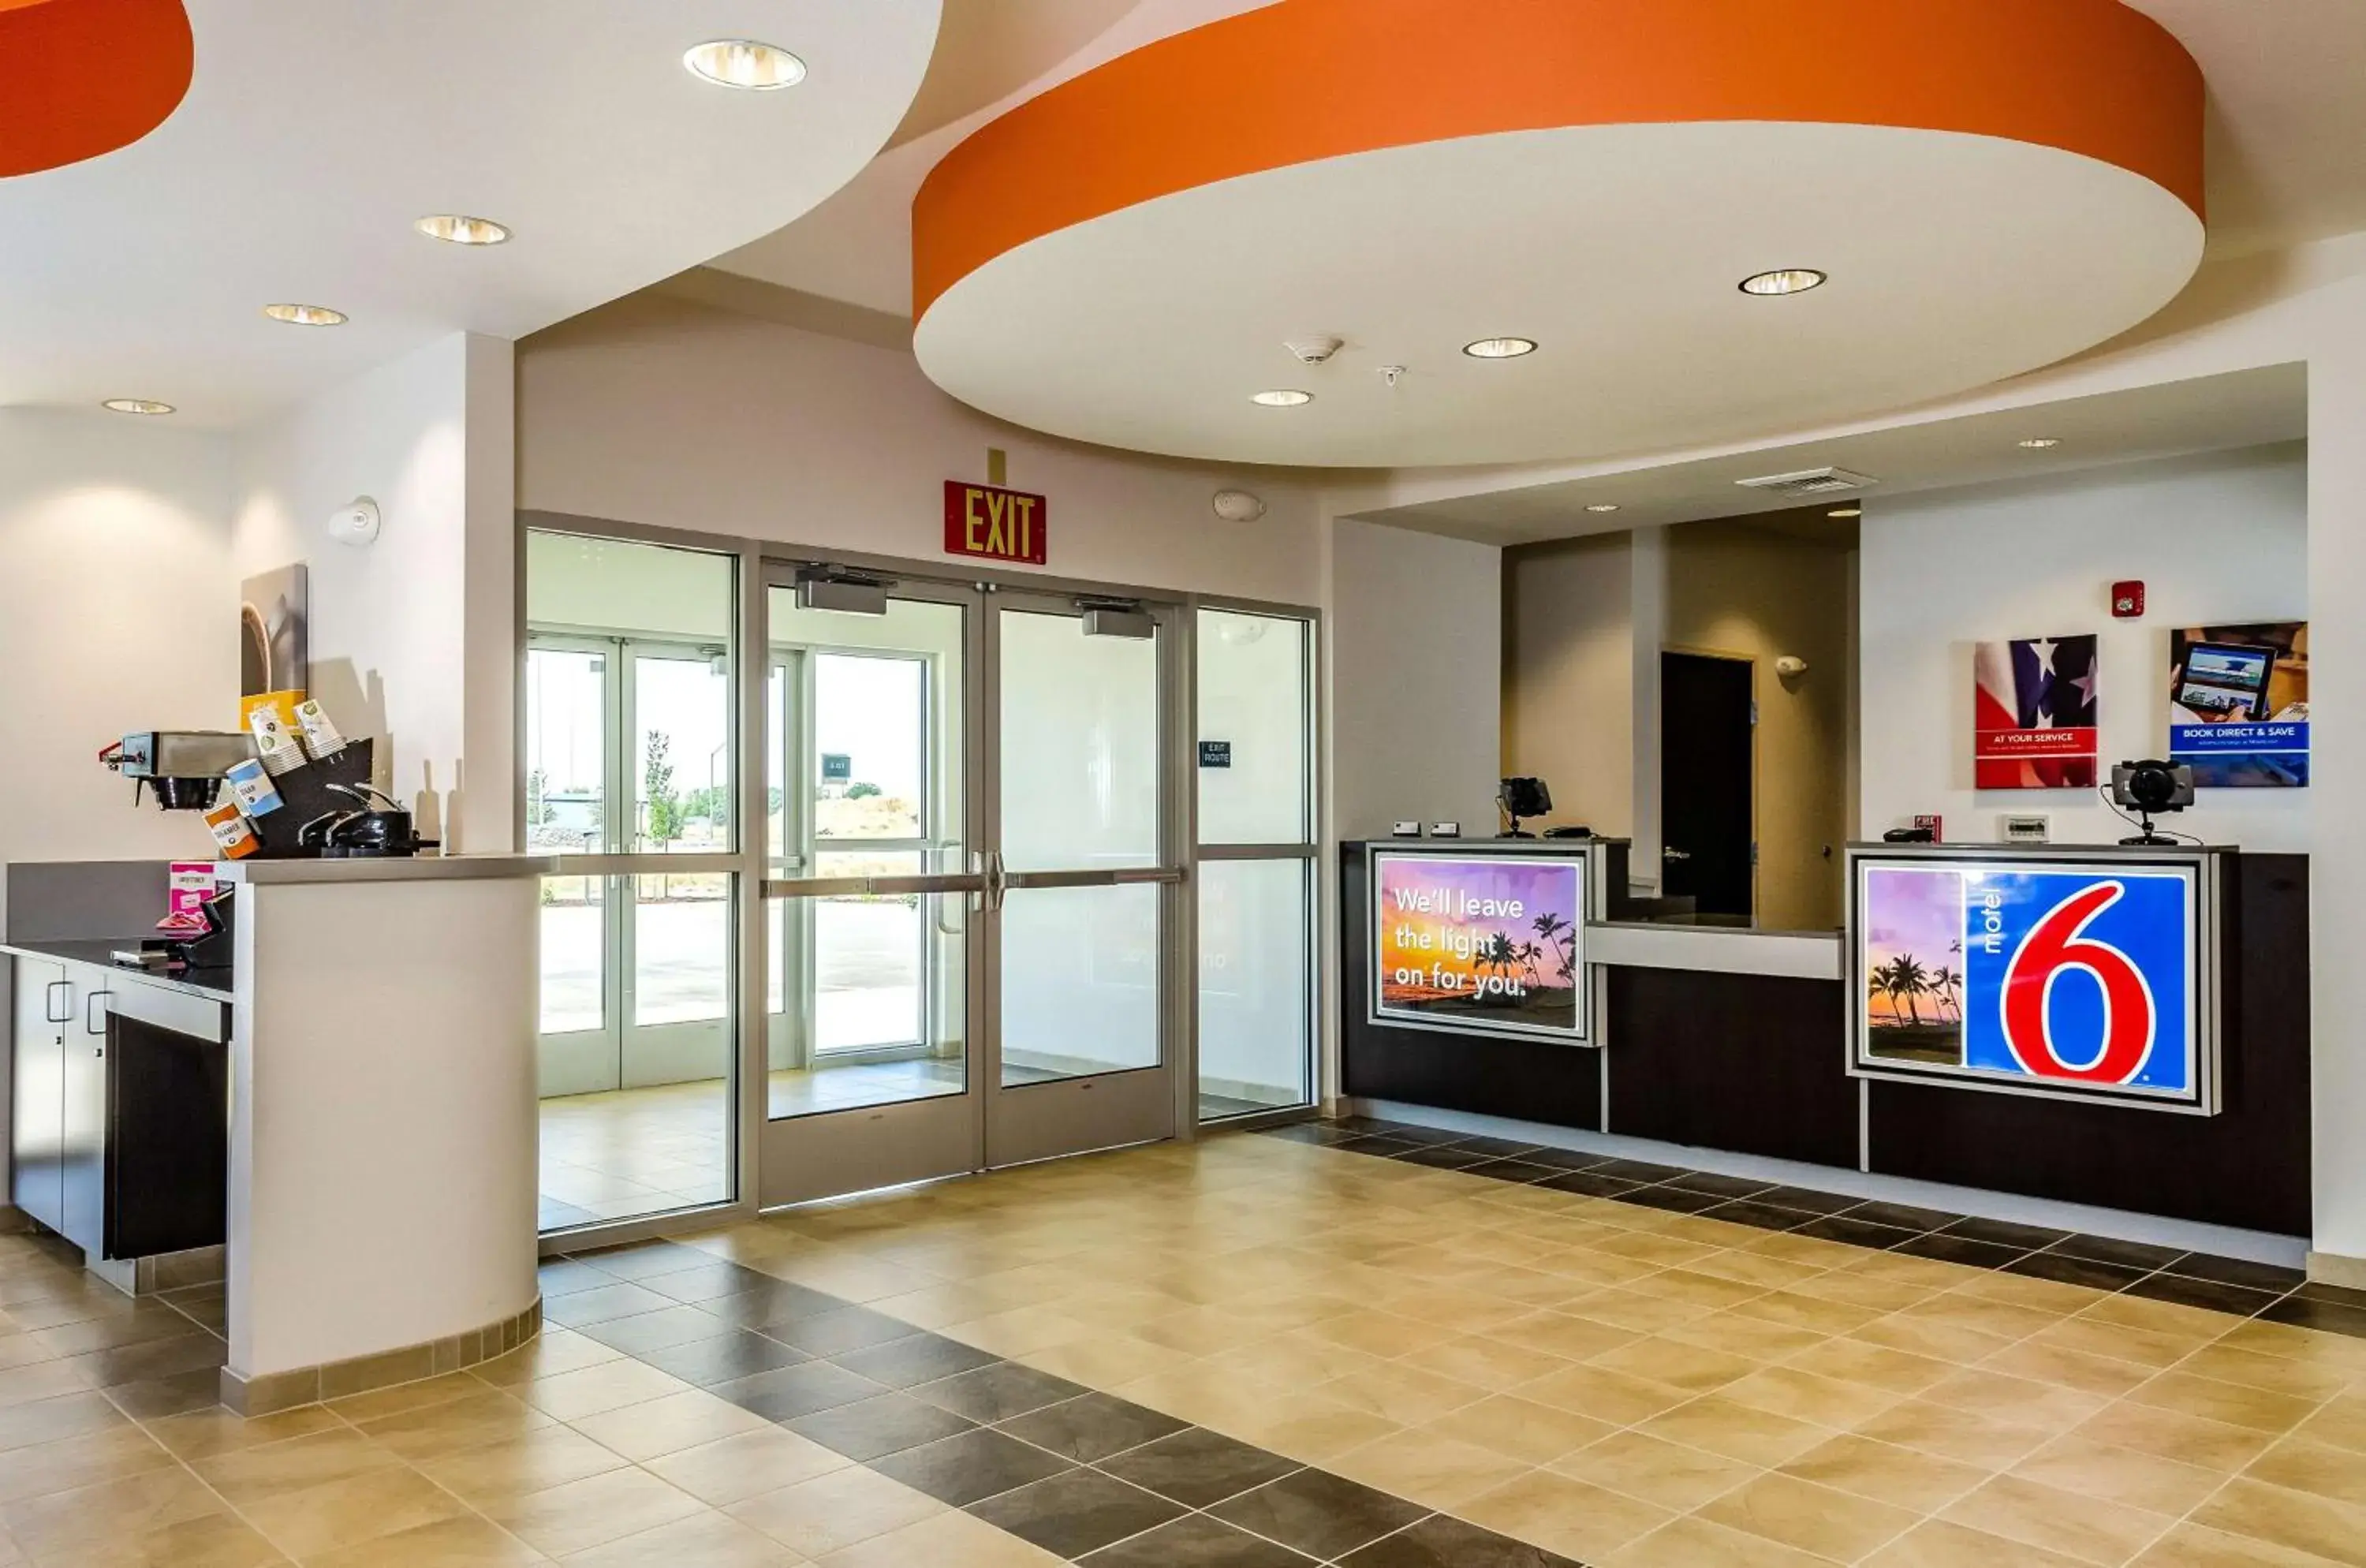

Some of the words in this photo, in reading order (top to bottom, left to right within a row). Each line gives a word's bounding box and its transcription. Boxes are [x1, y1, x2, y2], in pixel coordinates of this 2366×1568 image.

[966, 488, 1035, 558] EXIT
[2008, 734, 2032, 742] YOUR
[2035, 733, 2073, 742] SERVICE
[2183, 729, 2214, 737] BOOK
[2217, 728, 2253, 737] DIRECT
[2256, 727, 2265, 736] &
[2267, 726, 2296, 736] SAVE
[1460, 889, 1524, 918] leave
[1395, 923, 1432, 950] the
[1440, 926, 1498, 960] light
[1395, 966, 1424, 986] on
[1432, 961, 1468, 990] for
[1980, 888, 2002, 954] motel
[1999, 879, 2157, 1085] 6
